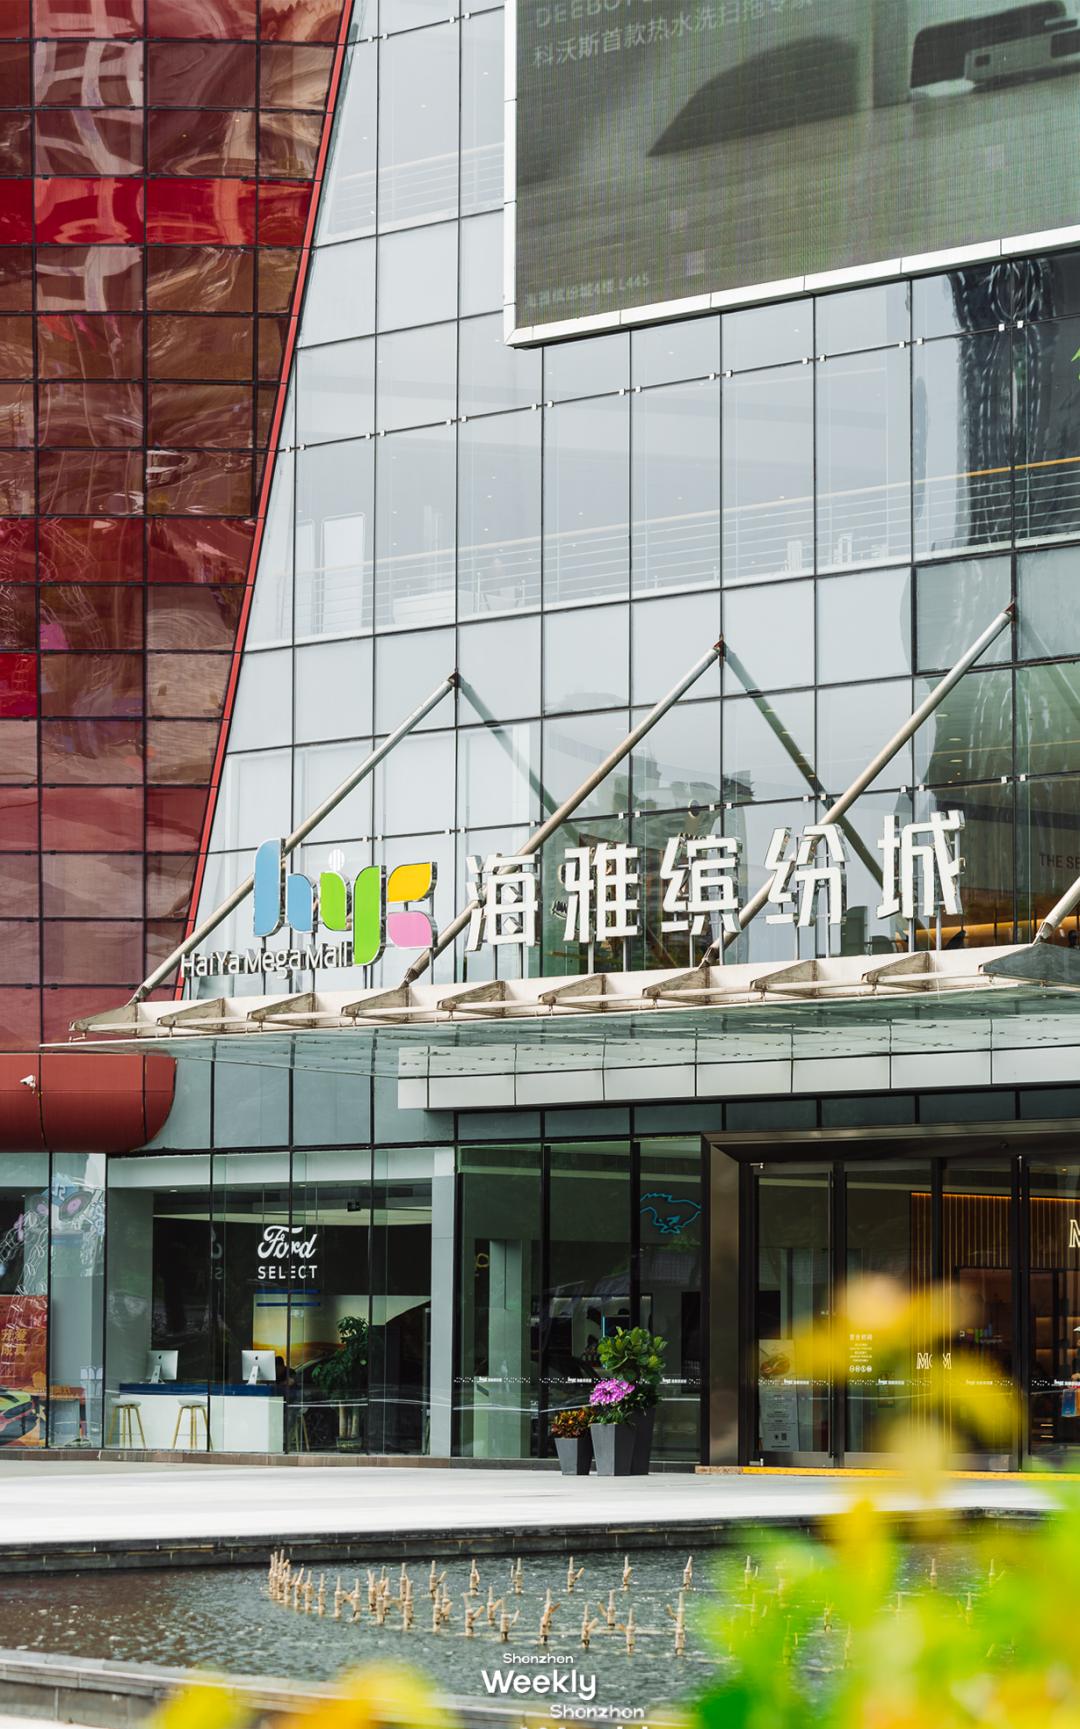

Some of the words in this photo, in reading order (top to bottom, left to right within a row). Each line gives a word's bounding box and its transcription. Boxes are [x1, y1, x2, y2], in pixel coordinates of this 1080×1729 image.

[1039, 852, 1063, 868] THE
[465, 810, 965, 952] 海雅缤纷城
[245, 948, 302, 979] Mega
[306, 941, 350, 970] Mall
[257, 1225, 318, 1259] Ford
[257, 1265, 318, 1279] SELECT
